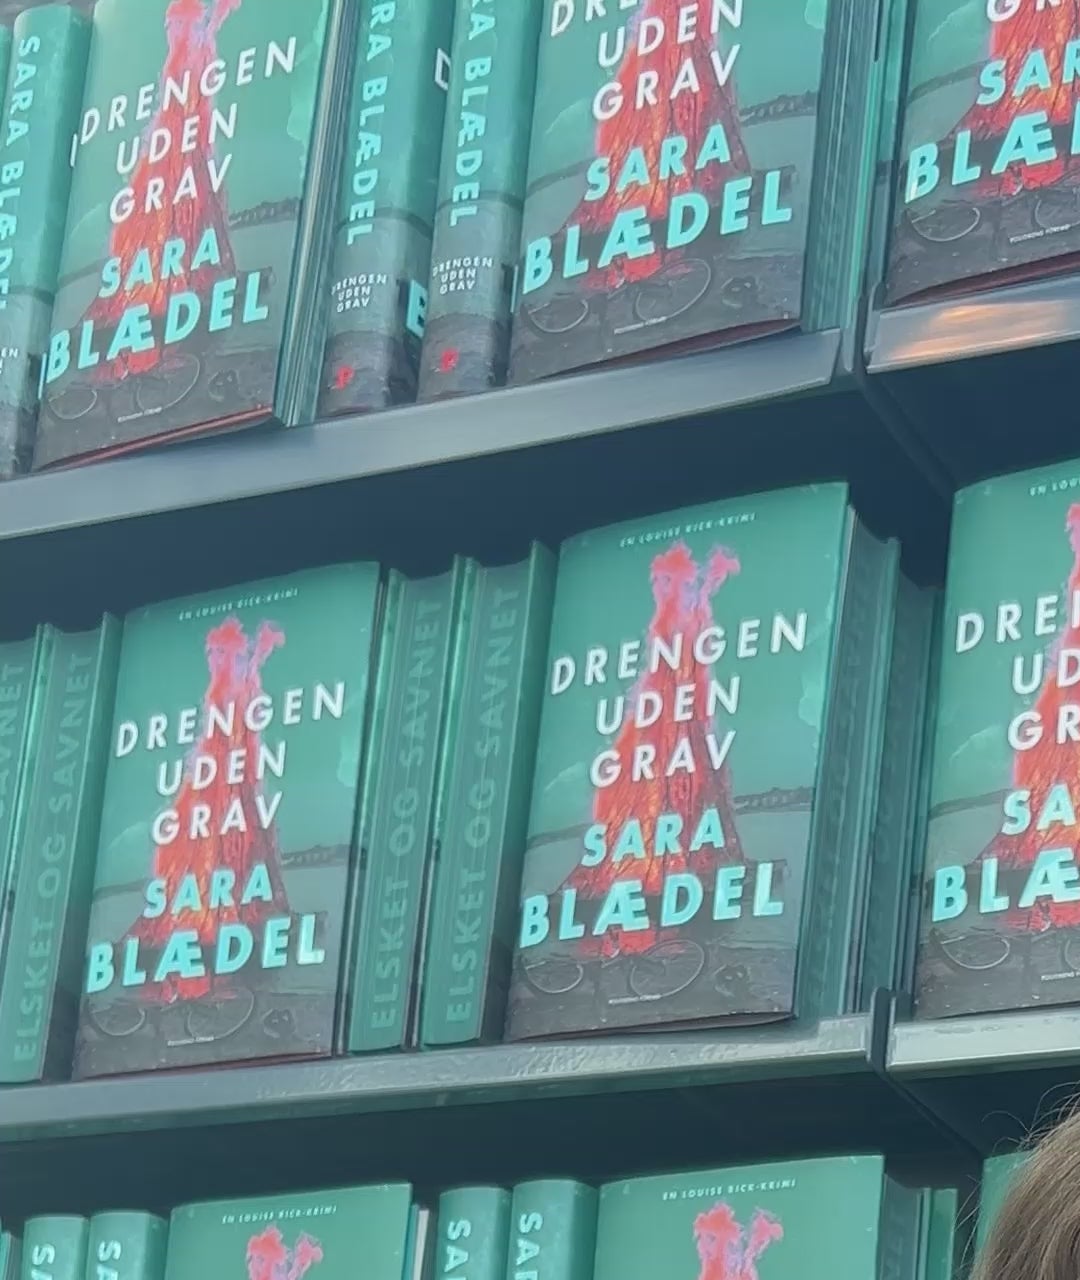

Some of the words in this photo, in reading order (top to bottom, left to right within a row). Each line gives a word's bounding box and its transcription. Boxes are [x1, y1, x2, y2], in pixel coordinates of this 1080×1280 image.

[600, 0, 743, 67] UDEN
[6, 37, 39, 146] SARA
[81, 37, 296, 145] DRENGEN
[592, 44, 740, 120] GRAV
[117, 104, 238, 174] UDEN
[347, 77, 388, 246] BLÆDEL
[450, 57, 491, 226] BLÆDEL
[585, 125, 730, 201] SARA
[110, 154, 233, 224] GRAV
[99, 227, 219, 297] SARA
[523, 171, 792, 294] BLÆDEL
[46, 272, 268, 383] BLÆDEL
[550, 612, 807, 694] DRENGEN
[115, 681, 346, 757] DRENGEN
[595, 677, 740, 736] UDEN
[157, 741, 287, 797] UDEN
[589, 731, 737, 788] GRAV
[151, 793, 281, 845] GRAV
[581, 808, 725, 867] SARA
[143, 864, 273, 918] SARA
[519, 861, 785, 948] BLÆDEL
[86, 914, 326, 994] BLÆDEL
